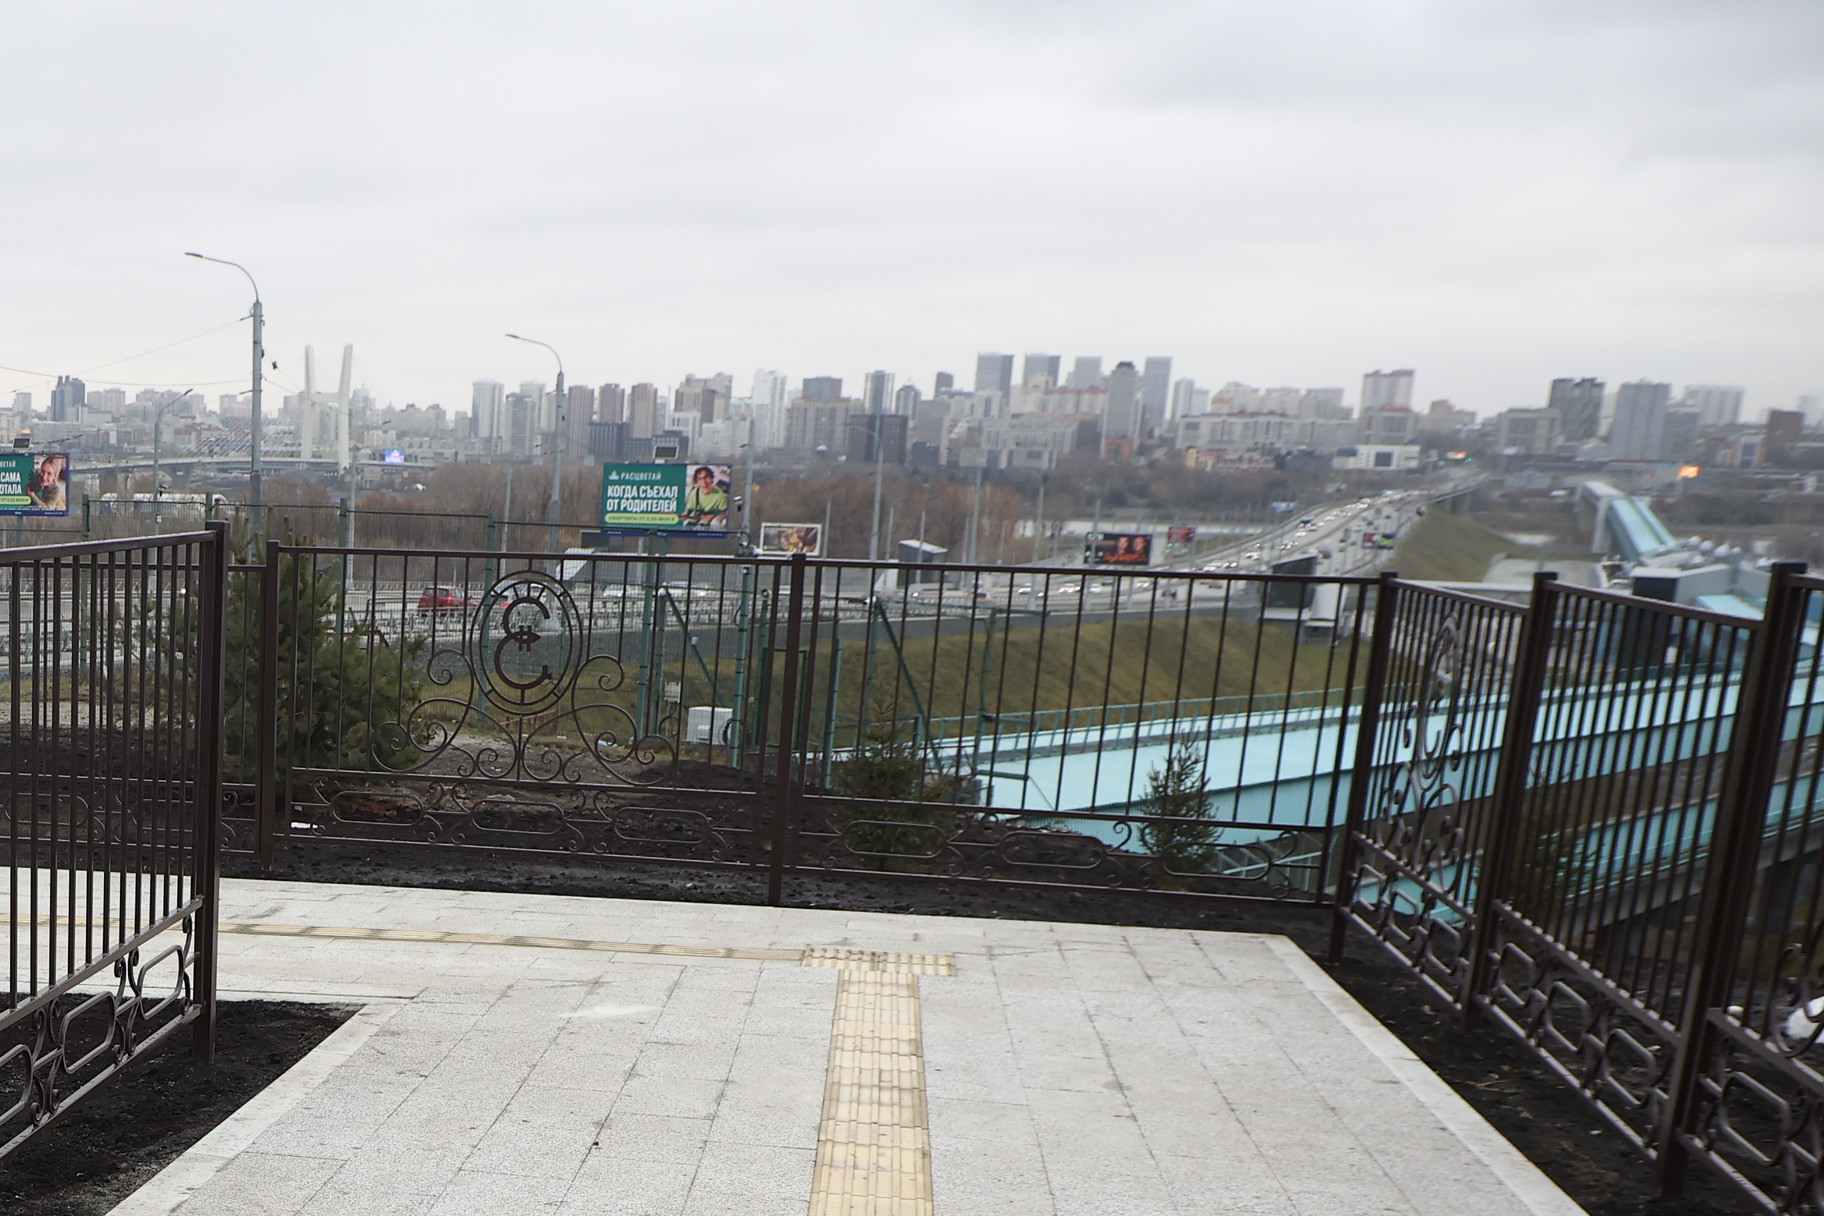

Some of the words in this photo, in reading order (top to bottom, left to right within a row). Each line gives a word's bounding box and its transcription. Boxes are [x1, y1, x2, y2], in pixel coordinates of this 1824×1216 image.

[1, 472, 20, 482] САМА
[608, 486, 637, 498] КОГДА
[640, 486, 678, 497] СЪЕХАЛ
[607, 500, 618, 511] ОТ
[621, 499, 677, 513] РОДИТЕЛЕЙ
